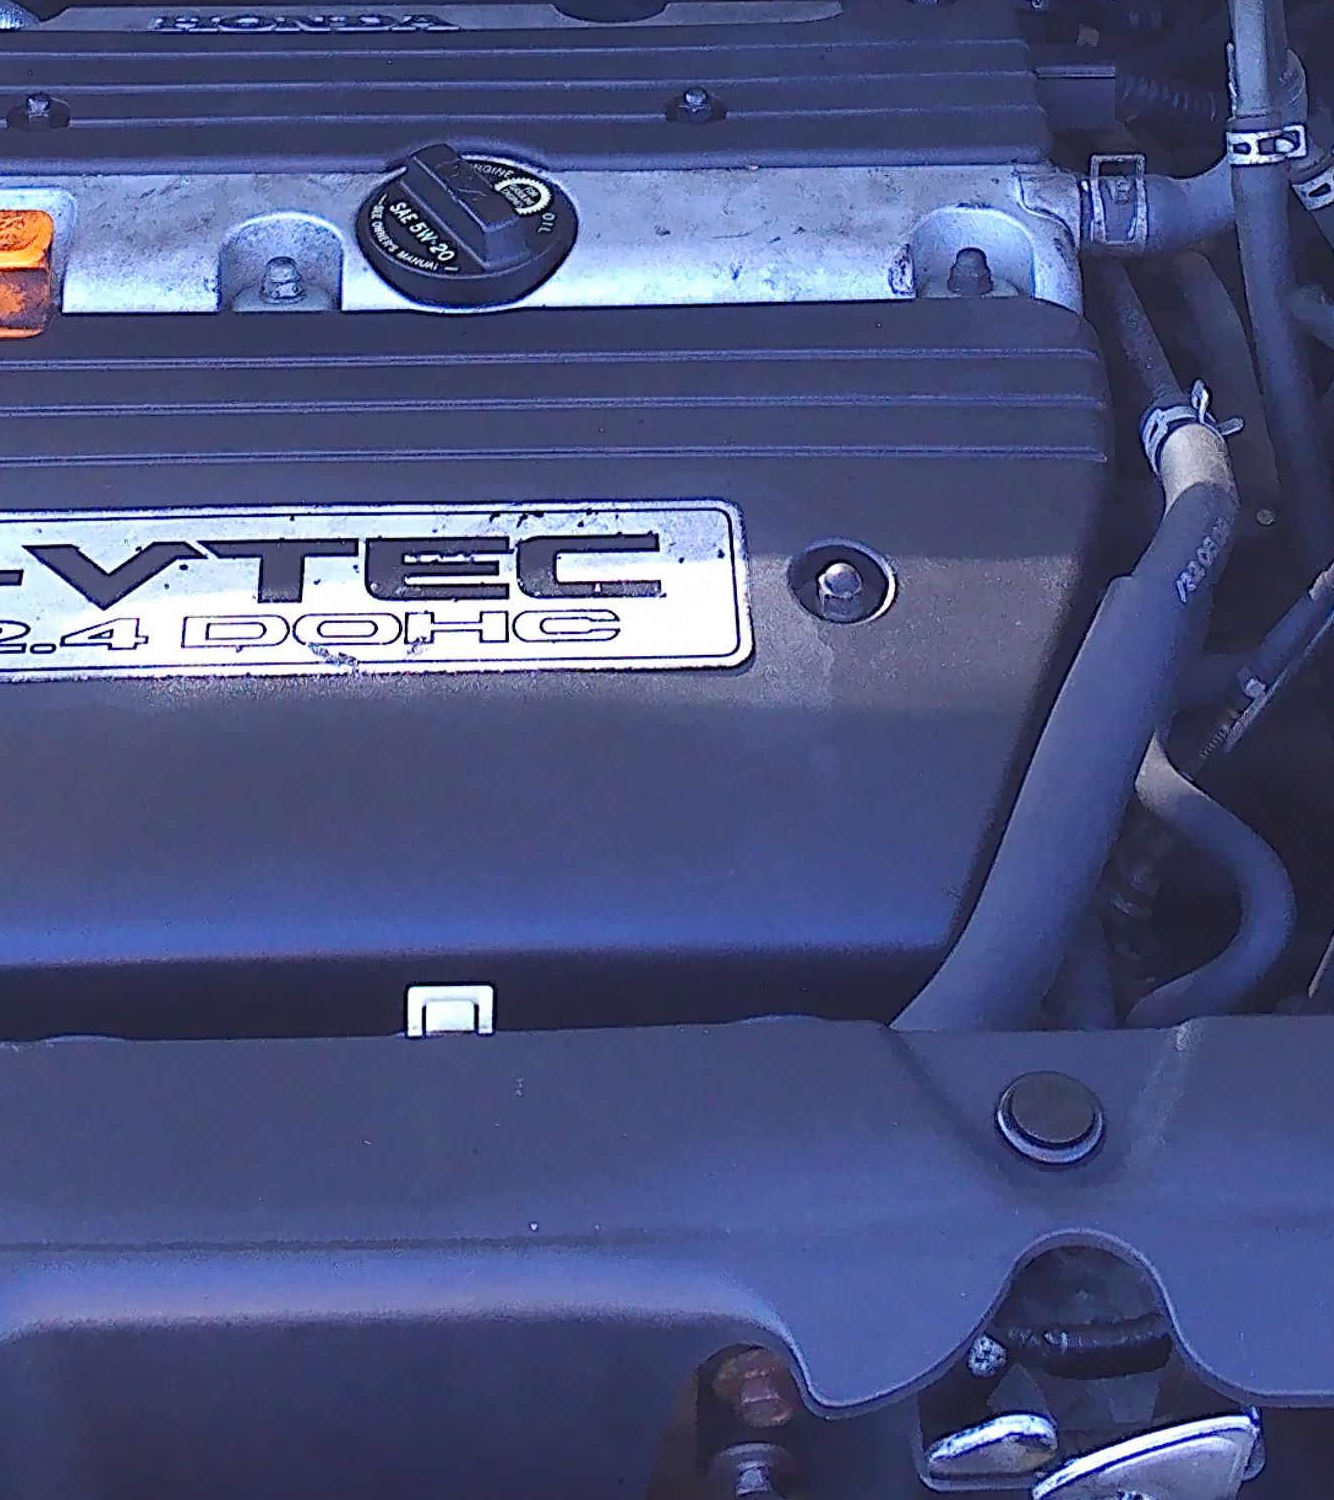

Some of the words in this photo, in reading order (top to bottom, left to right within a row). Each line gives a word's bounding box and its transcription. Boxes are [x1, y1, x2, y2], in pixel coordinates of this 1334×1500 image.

[473, 163, 515, 178] NGINE
[389, 201, 418, 225] SAE
[537, 211, 556, 234] OIL
[180, 608, 624, 649] DOHC
